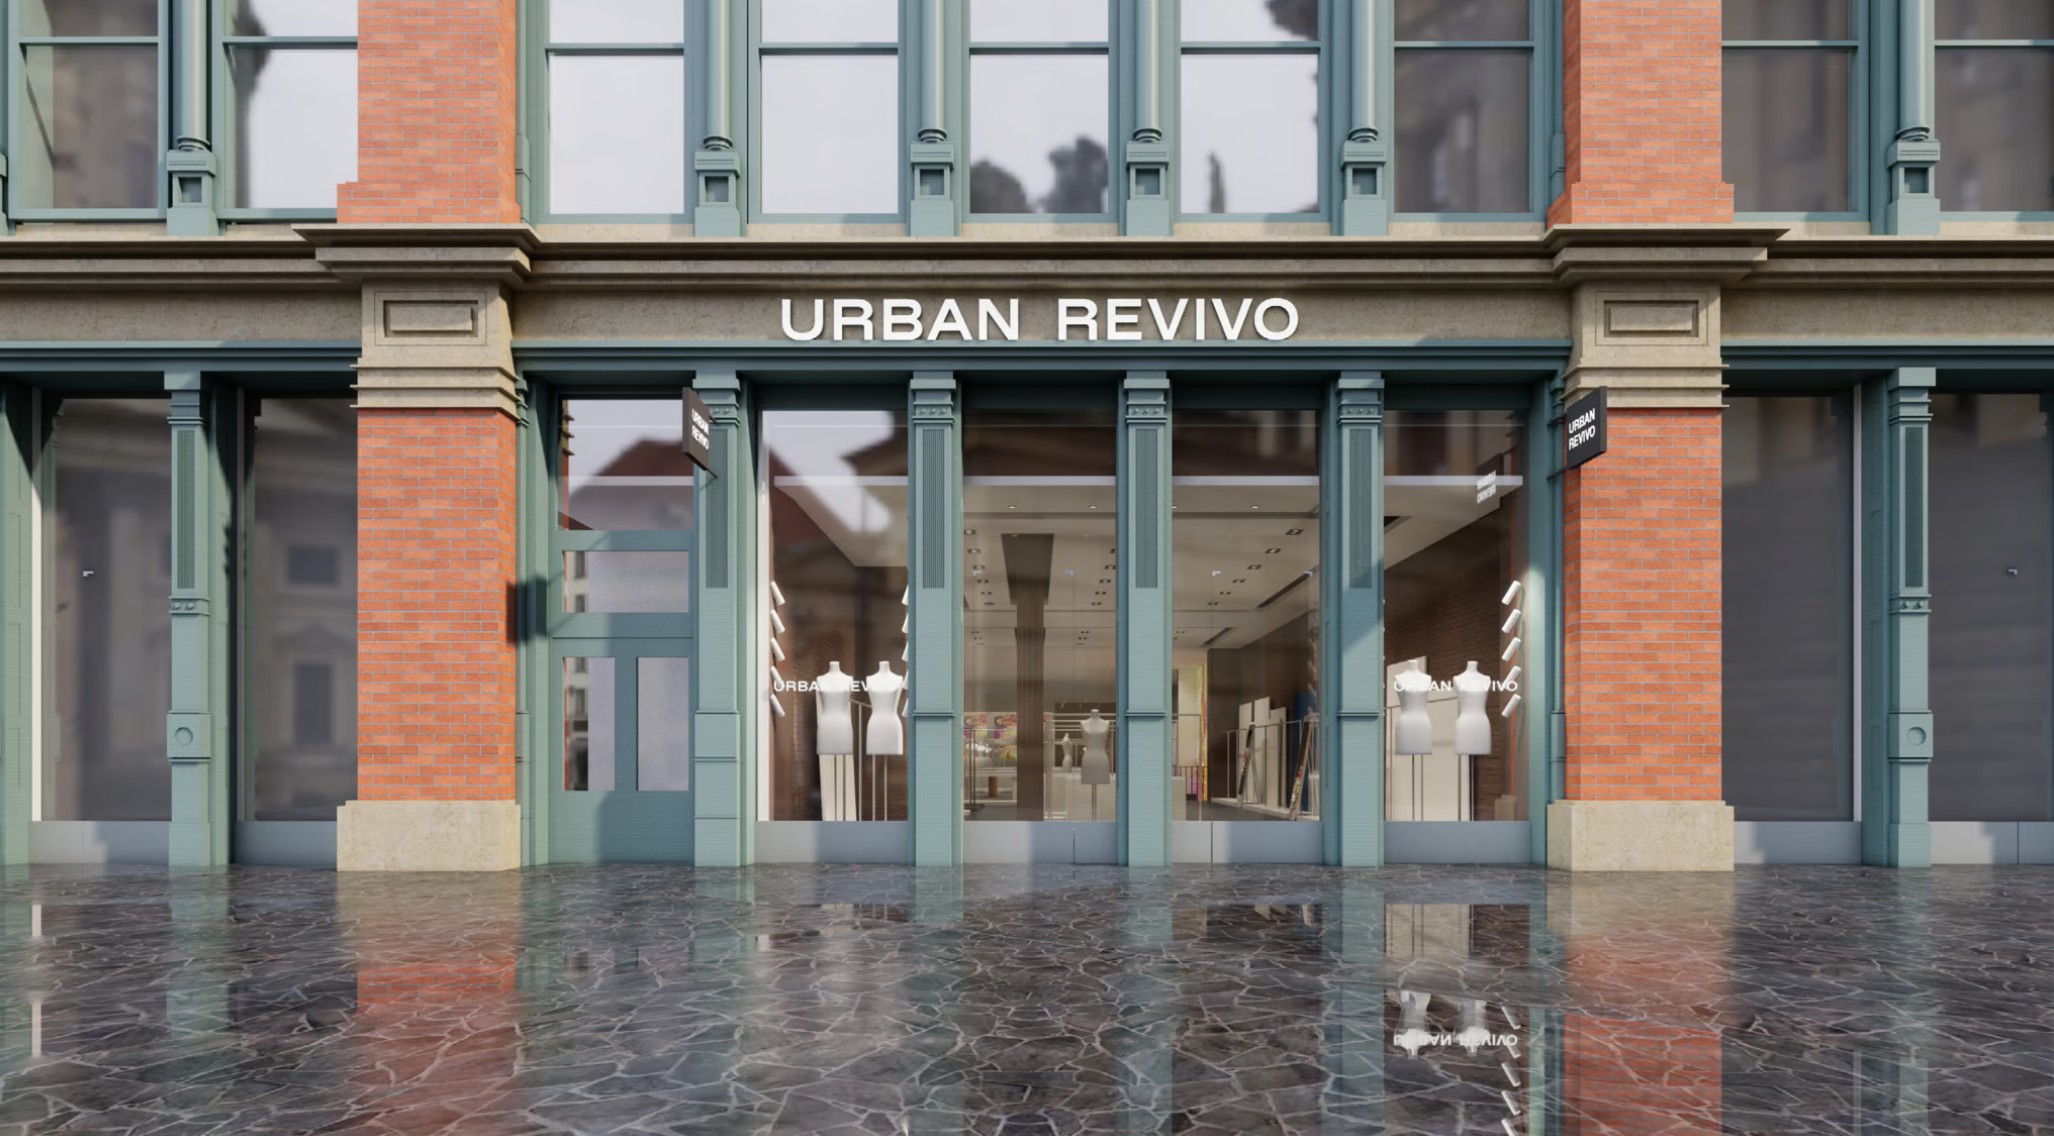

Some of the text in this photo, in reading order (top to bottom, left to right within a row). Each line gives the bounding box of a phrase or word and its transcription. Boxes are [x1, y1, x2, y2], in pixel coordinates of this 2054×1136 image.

[782, 297, 1299, 341] URBAN REVIVO
[1568, 407, 1596, 434] URBAN
[1568, 425, 1596, 451] REVIVO
[773, 680, 822, 692] URBA
